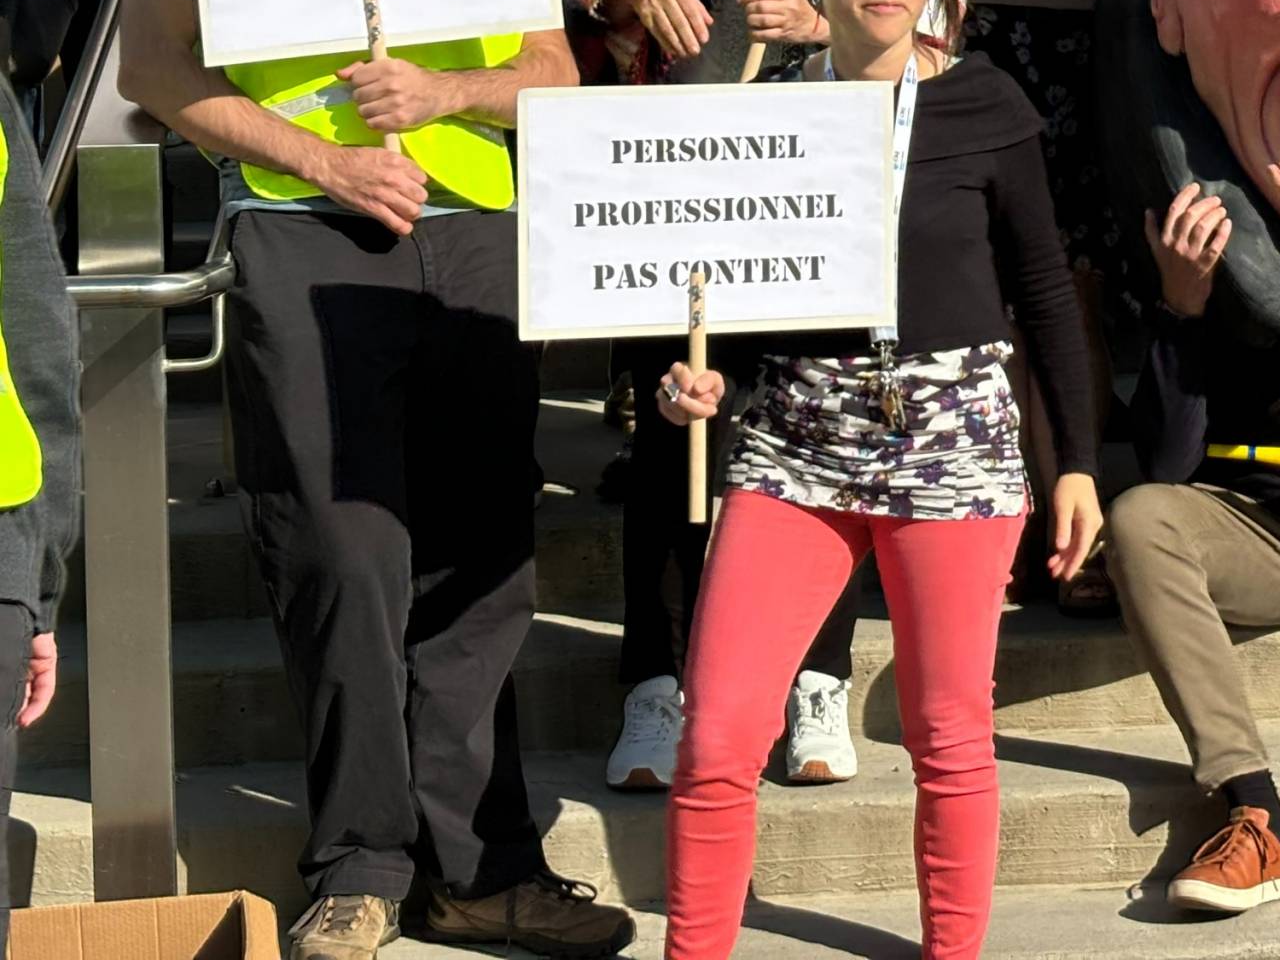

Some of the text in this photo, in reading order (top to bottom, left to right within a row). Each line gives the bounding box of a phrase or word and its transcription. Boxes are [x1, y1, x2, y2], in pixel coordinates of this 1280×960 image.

[612, 135, 804, 163] PERSONNEL
[576, 195, 842, 227] PROFESSIONNEL
[594, 263, 657, 289] PAS
